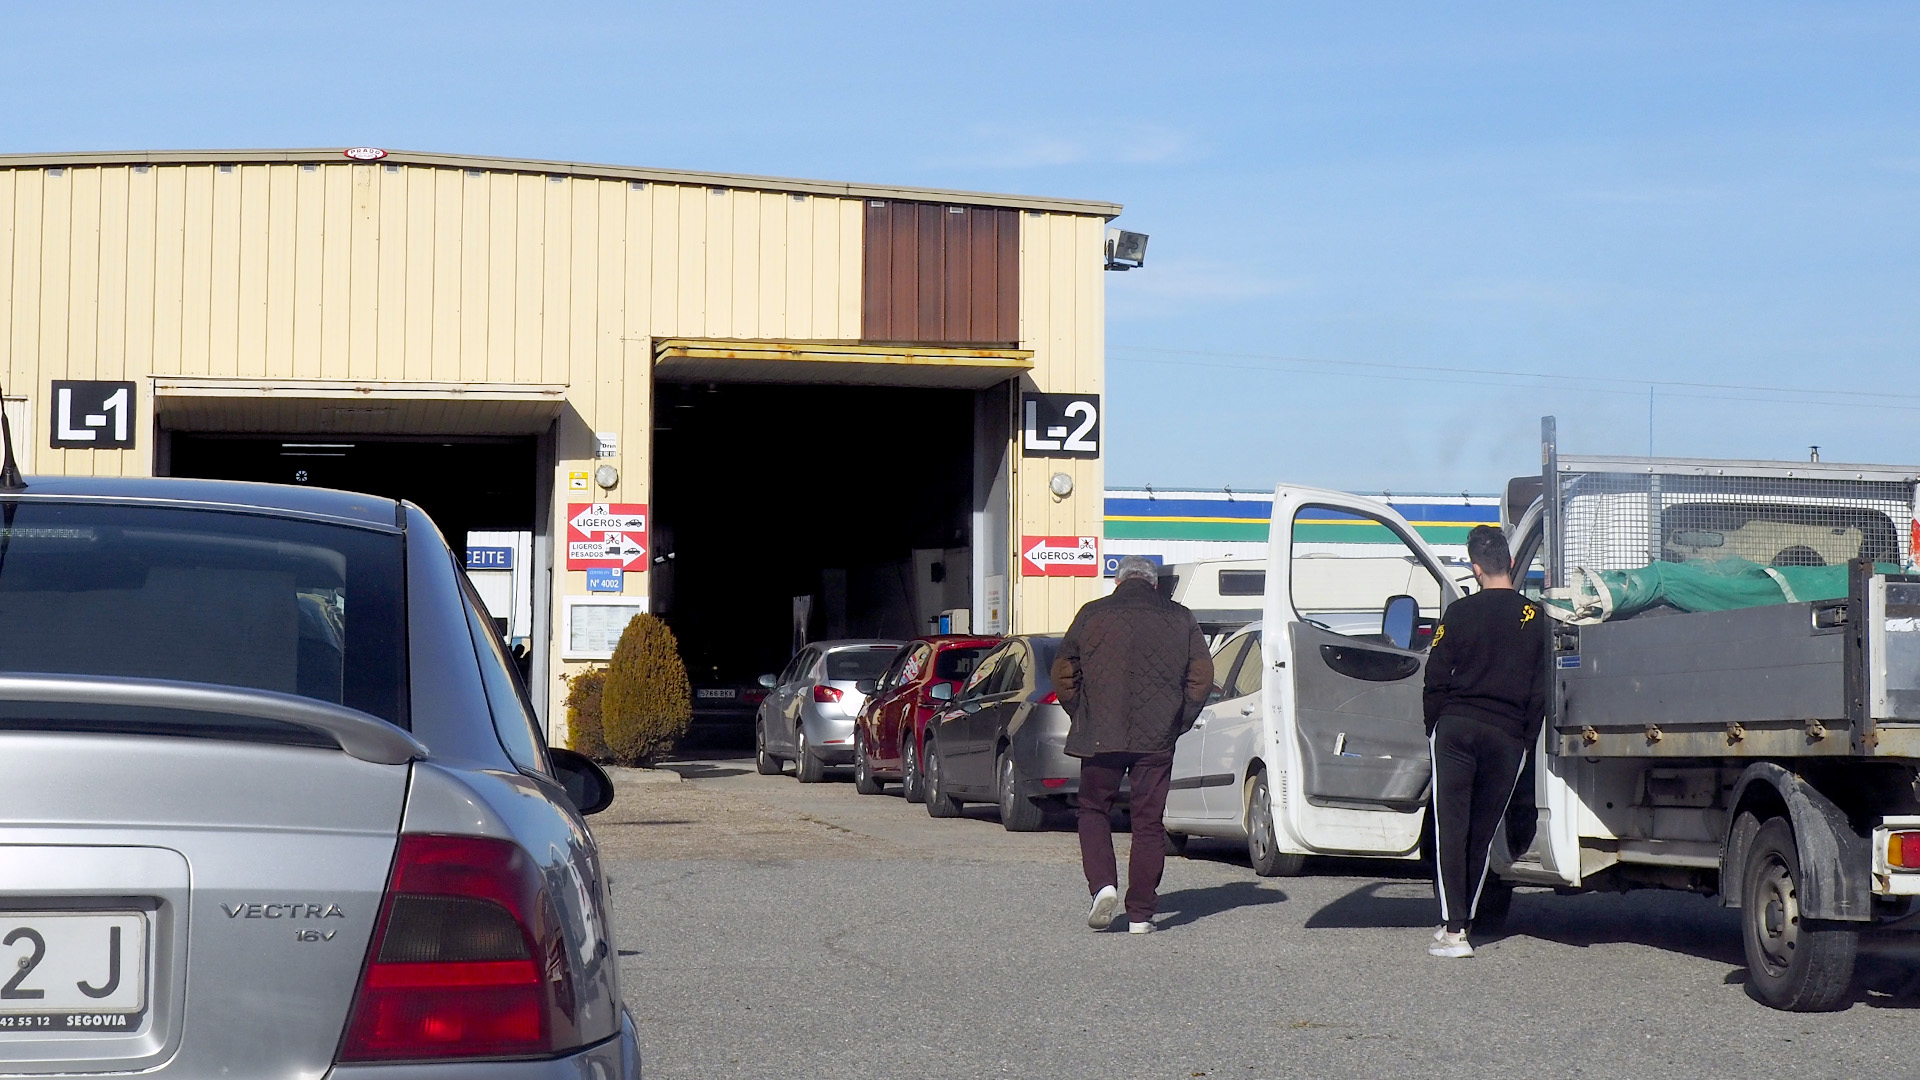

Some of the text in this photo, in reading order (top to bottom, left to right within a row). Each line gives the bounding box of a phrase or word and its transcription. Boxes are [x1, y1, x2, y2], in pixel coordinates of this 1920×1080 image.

[58, 388, 128, 441] L-1
[1025, 401, 1097, 452] L-2
[577, 518, 621, 527] LIGEROS
[1031, 551, 1075, 561] LIGEROS
[601, 579, 619, 588] 4002
[219, 902, 345, 919] VECTRA
[296, 929, 338, 942] 16V
[76, 926, 121, 999] J
[18, 1017, 32, 1026] 55
[37, 1016, 50, 1026] 12
[66, 1015, 126, 1026] SEGOVIA
